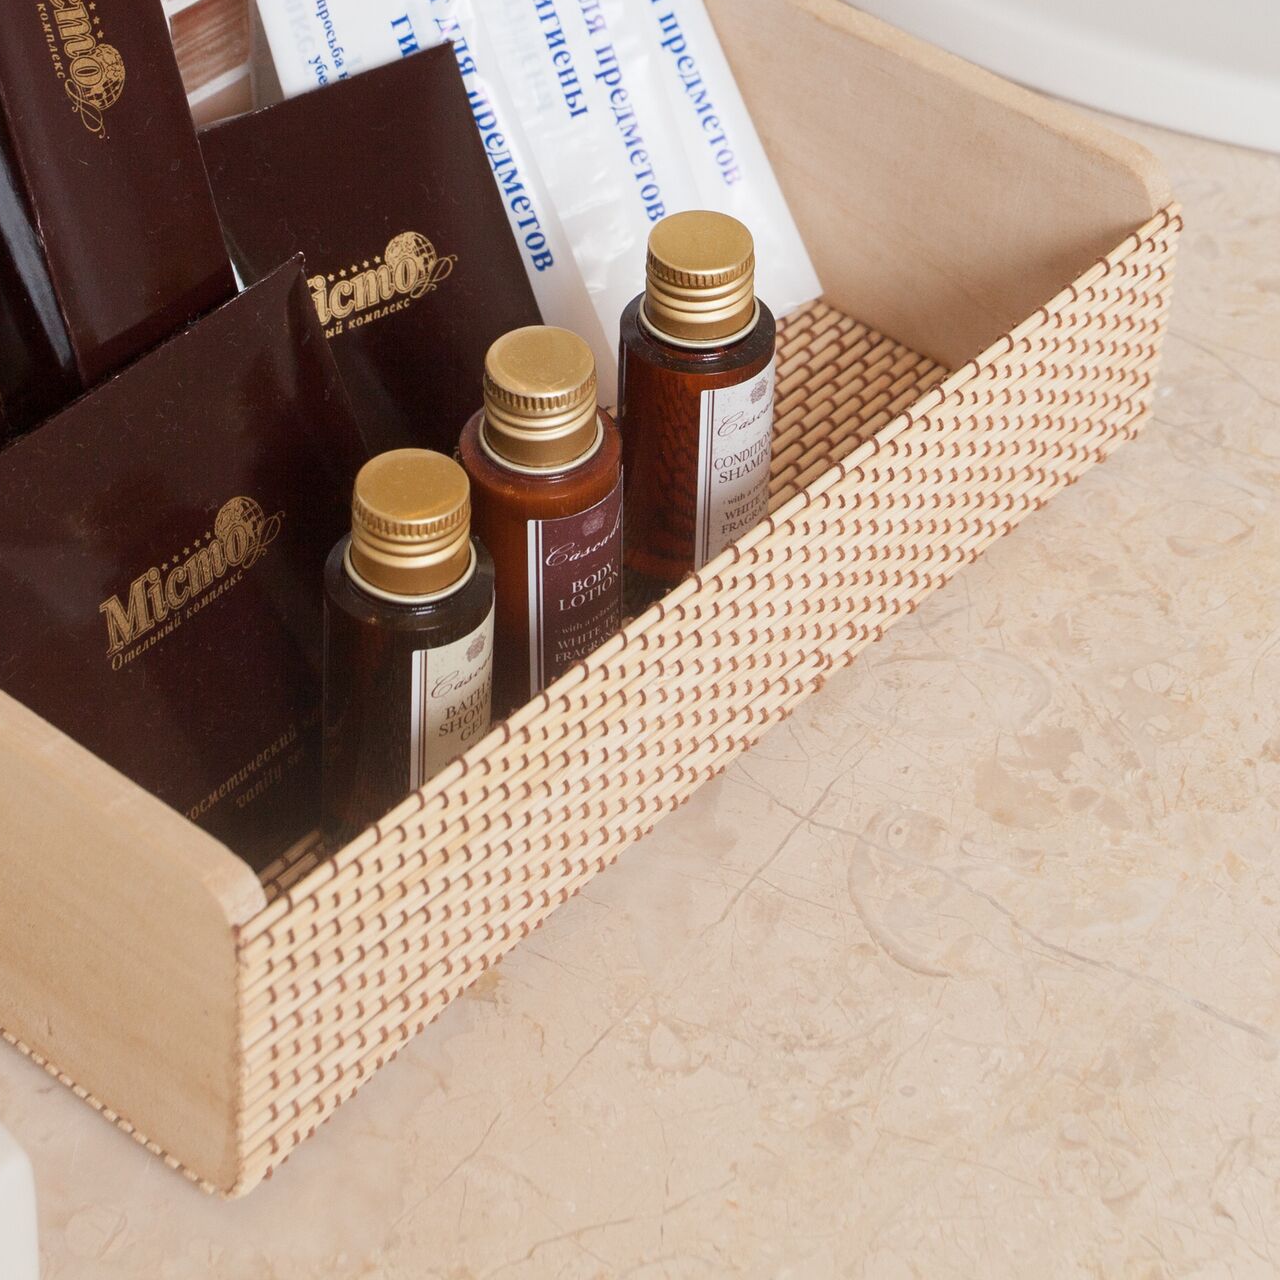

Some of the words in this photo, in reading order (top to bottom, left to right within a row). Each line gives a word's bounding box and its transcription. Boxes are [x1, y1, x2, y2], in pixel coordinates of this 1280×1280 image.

[37, 3, 67, 79] комплекс
[657, 10, 744, 187] предметов
[594, 43, 667, 222] предметов
[349, 298, 412, 330] комплекс
[558, 570, 620, 612] LOTION
[571, 557, 615, 595] BODY
[111, 612, 182, 672] Отельный
[186, 569, 244, 620] комплекс
[446, 681, 486, 721] BATH
[236, 763, 284, 810] vanity
